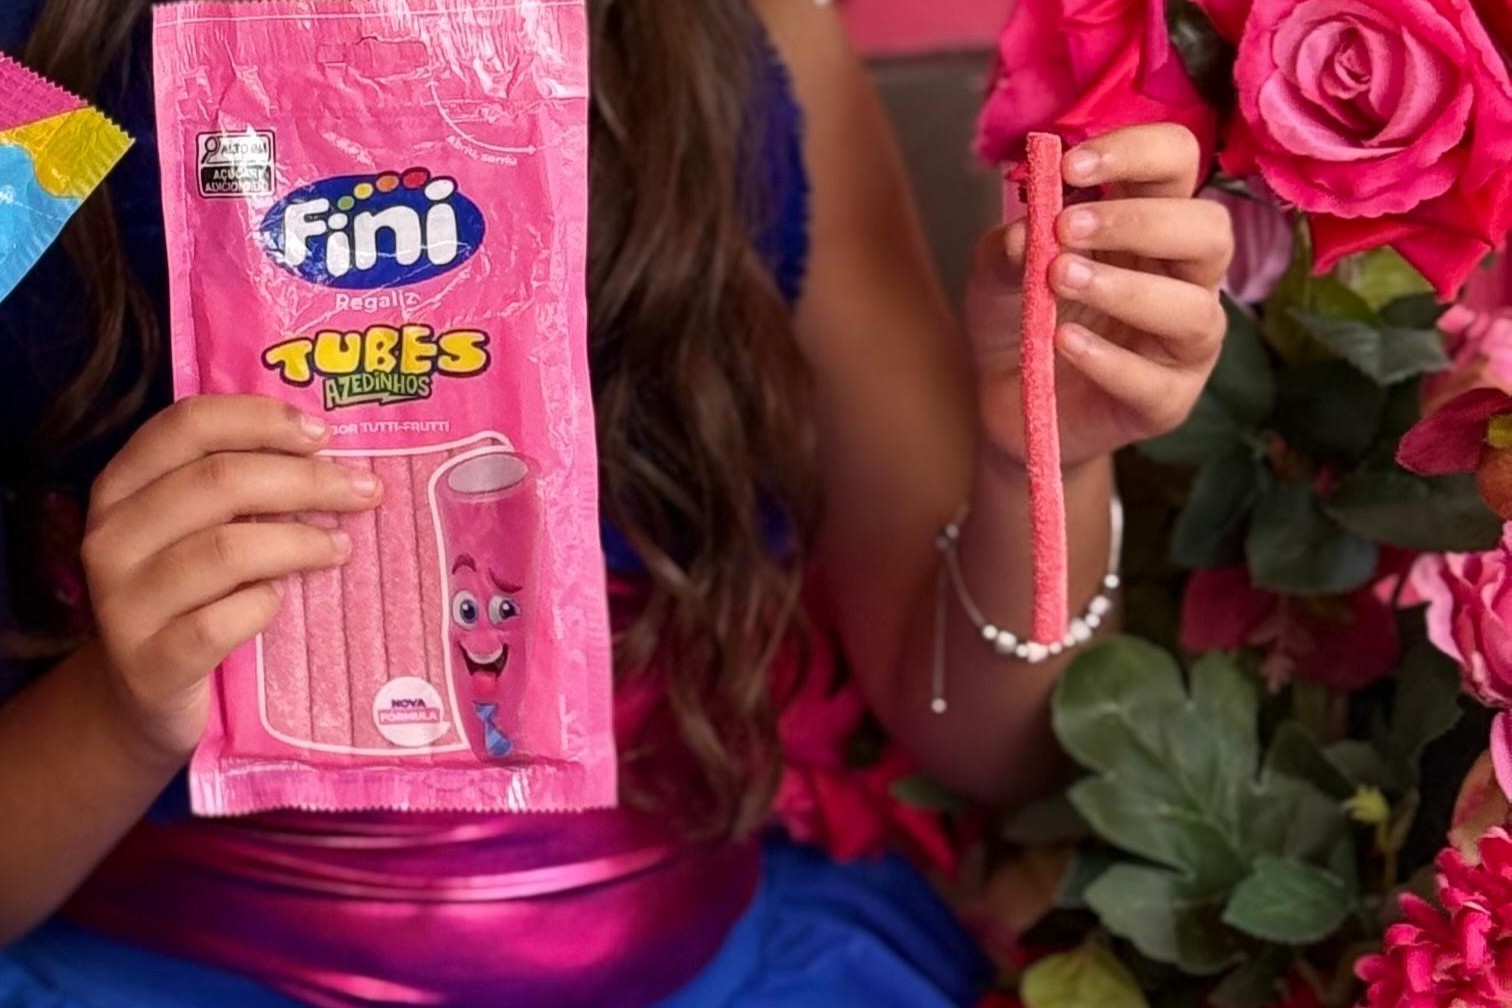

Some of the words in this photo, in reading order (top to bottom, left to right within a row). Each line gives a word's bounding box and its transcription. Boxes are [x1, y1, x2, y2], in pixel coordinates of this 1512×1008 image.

[335, 290, 421, 312] Regaliz
[262, 323, 490, 386] TUBES
[391, 698, 426, 709] NOVA
